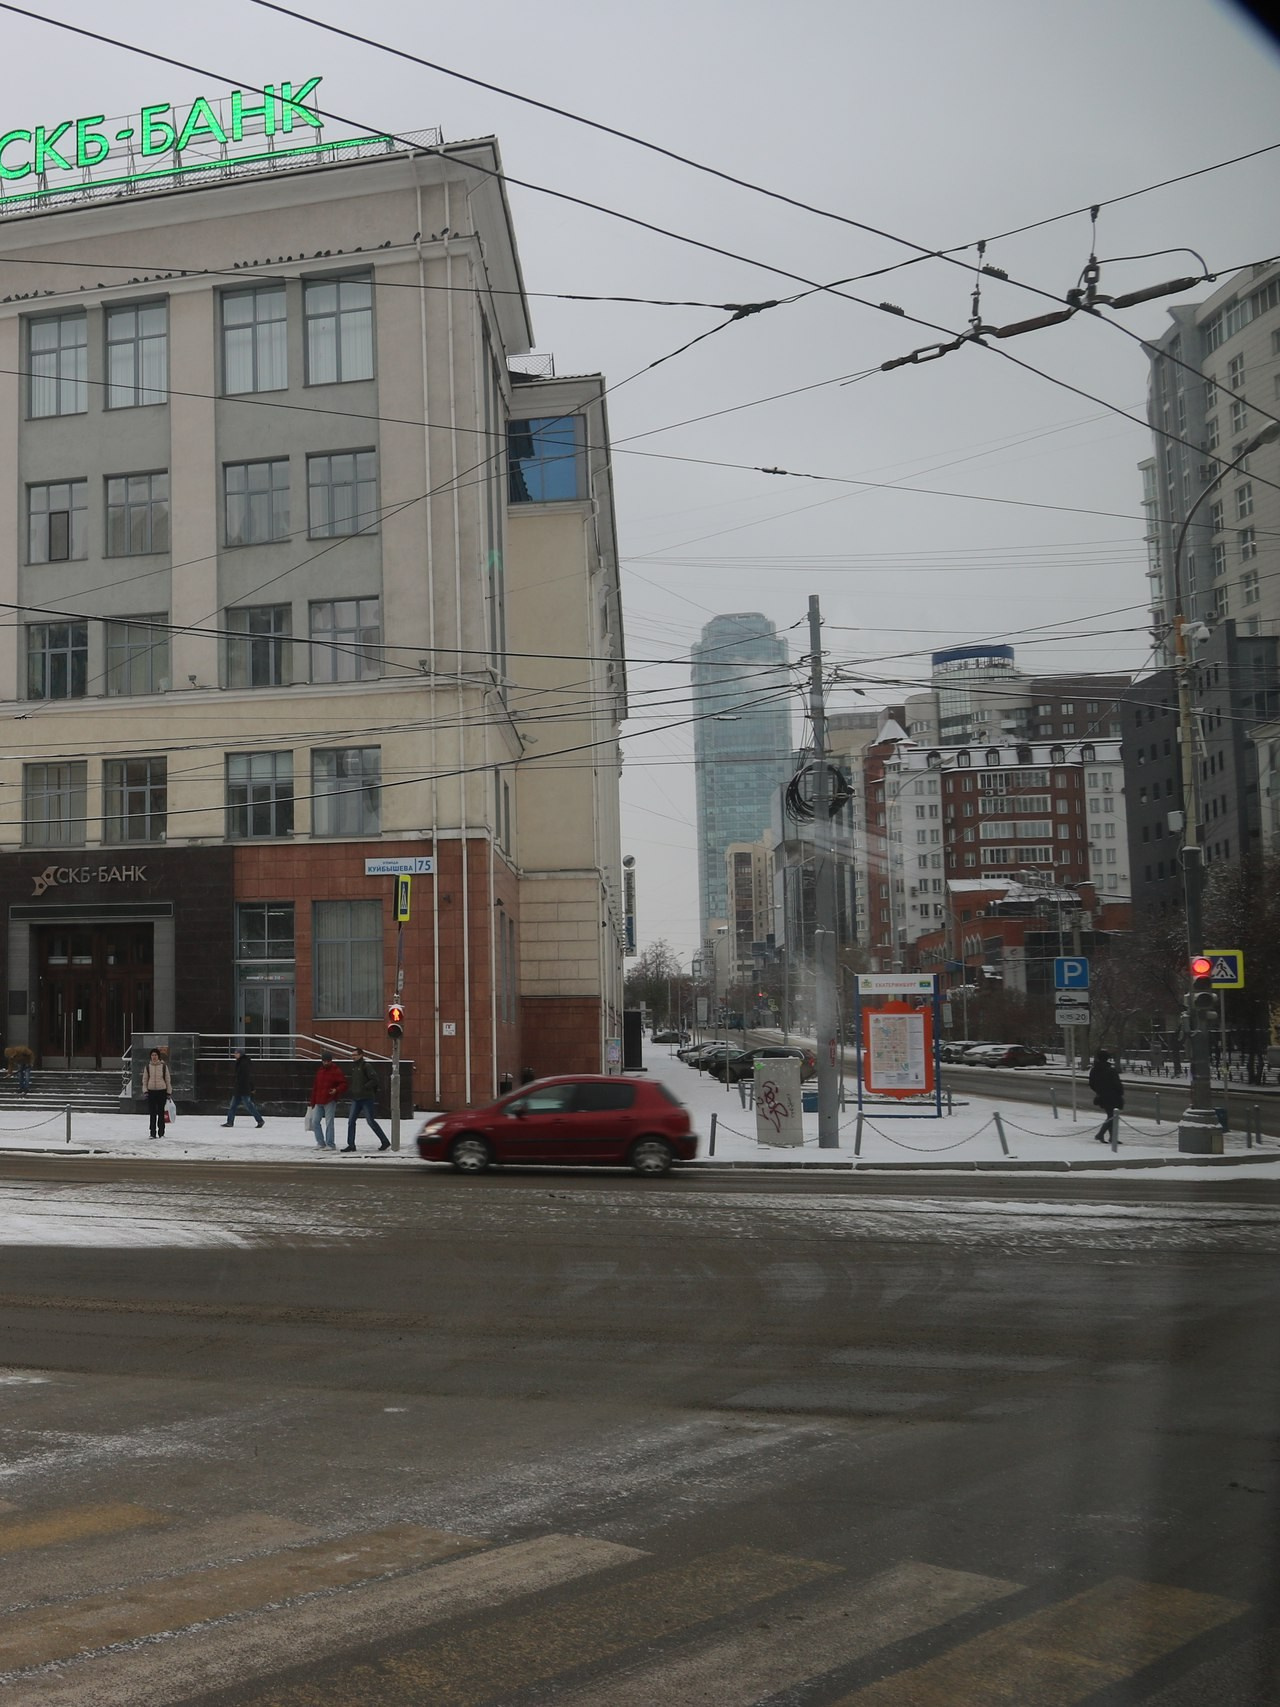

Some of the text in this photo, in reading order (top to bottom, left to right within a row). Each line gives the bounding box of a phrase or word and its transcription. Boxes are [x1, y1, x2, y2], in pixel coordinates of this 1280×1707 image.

[56, 865, 148, 884] СКБ-БАНК
[367, 860, 431, 873] КУЙБЫШЕВА 75
[1063, 961, 1082, 985] P
